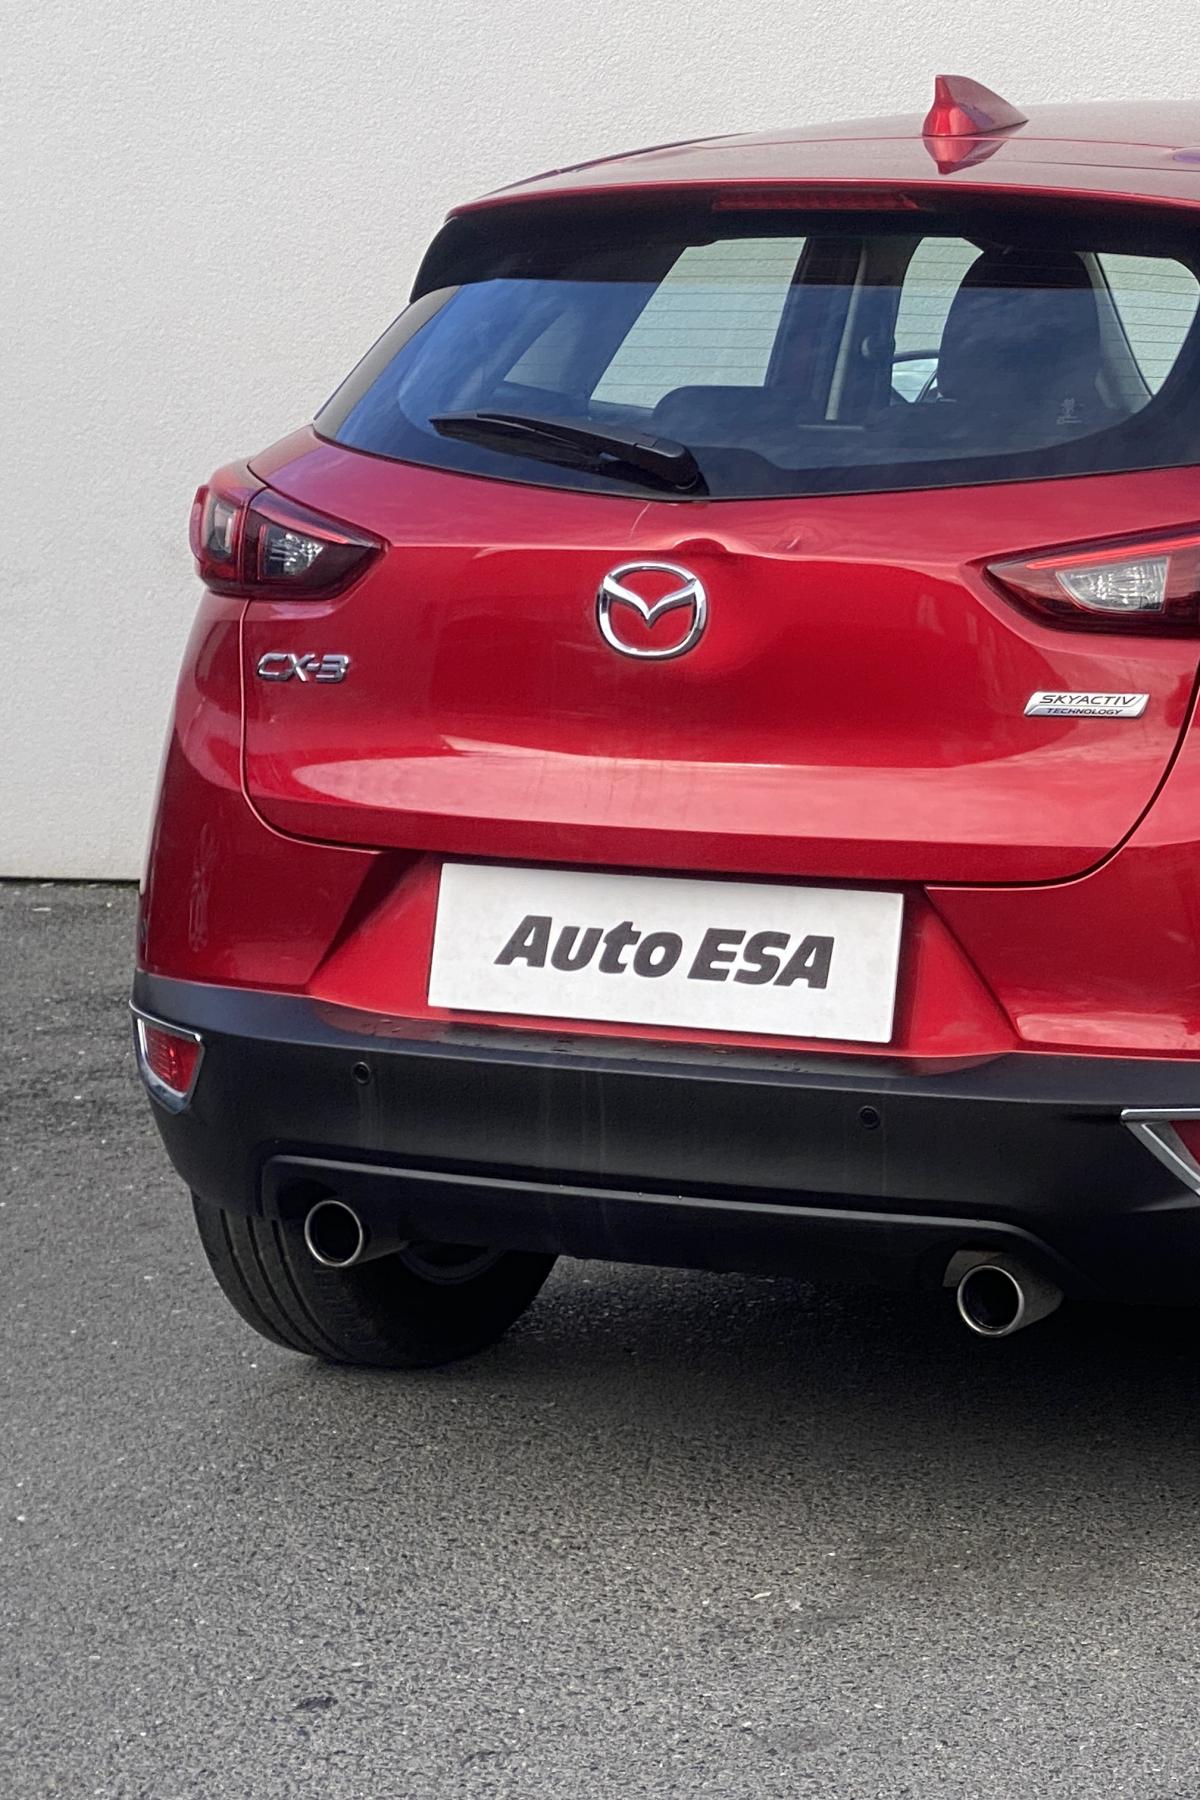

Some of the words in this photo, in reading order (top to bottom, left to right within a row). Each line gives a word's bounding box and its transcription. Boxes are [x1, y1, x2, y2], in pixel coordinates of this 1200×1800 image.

[257, 652, 350, 683] CX-3
[1039, 695, 1137, 706] SKYACTIV
[1047, 708, 1123, 716] TECHNOLOGY
[494, 915, 683, 978] Auto
[687, 928, 835, 989] ESA
